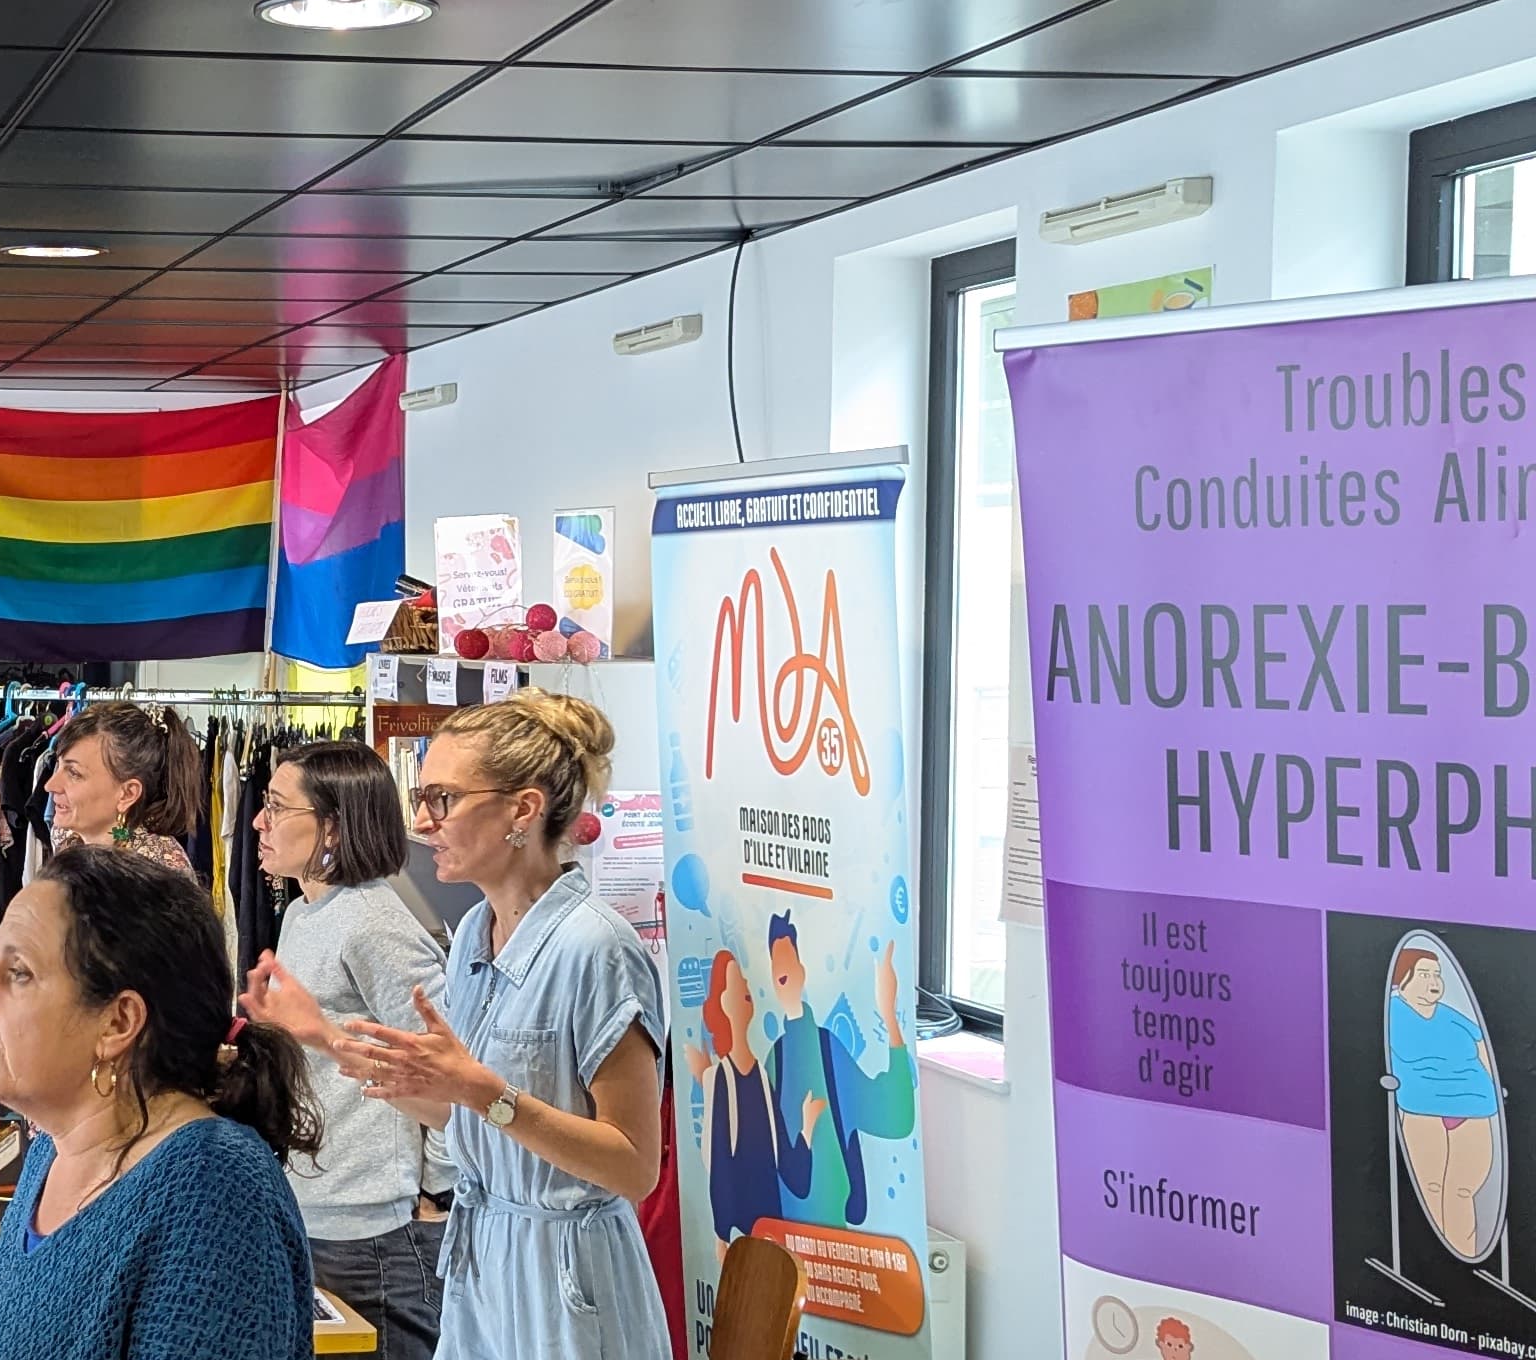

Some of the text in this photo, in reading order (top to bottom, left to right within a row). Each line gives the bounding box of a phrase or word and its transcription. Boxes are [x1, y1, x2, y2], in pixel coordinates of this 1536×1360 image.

[1275, 348, 1527, 433] Troubles
[676, 487, 880, 529] ACCUEIL LIBRE, GRATUIT ET CONFIDENTIEL
[1134, 457, 1401, 532] Conduites
[490, 668, 508, 684] FILMS
[820, 726, 840, 768] 35
[739, 806, 832, 845] MAISON DES ADOS
[743, 838, 830, 879] D'ILLE ET VILAINE
[1142, 911, 1208, 953] Il est
[1121, 957, 1232, 1003] toujours
[1131, 1004, 1216, 1050] temps
[1138, 1049, 1214, 1099] d'agir
[1103, 1168, 1261, 1238] S'informer
[1345, 1299, 1379, 1326] image
[1386, 1310, 1438, 1338] Christian
[1440, 1323, 1468, 1344] Dorn
